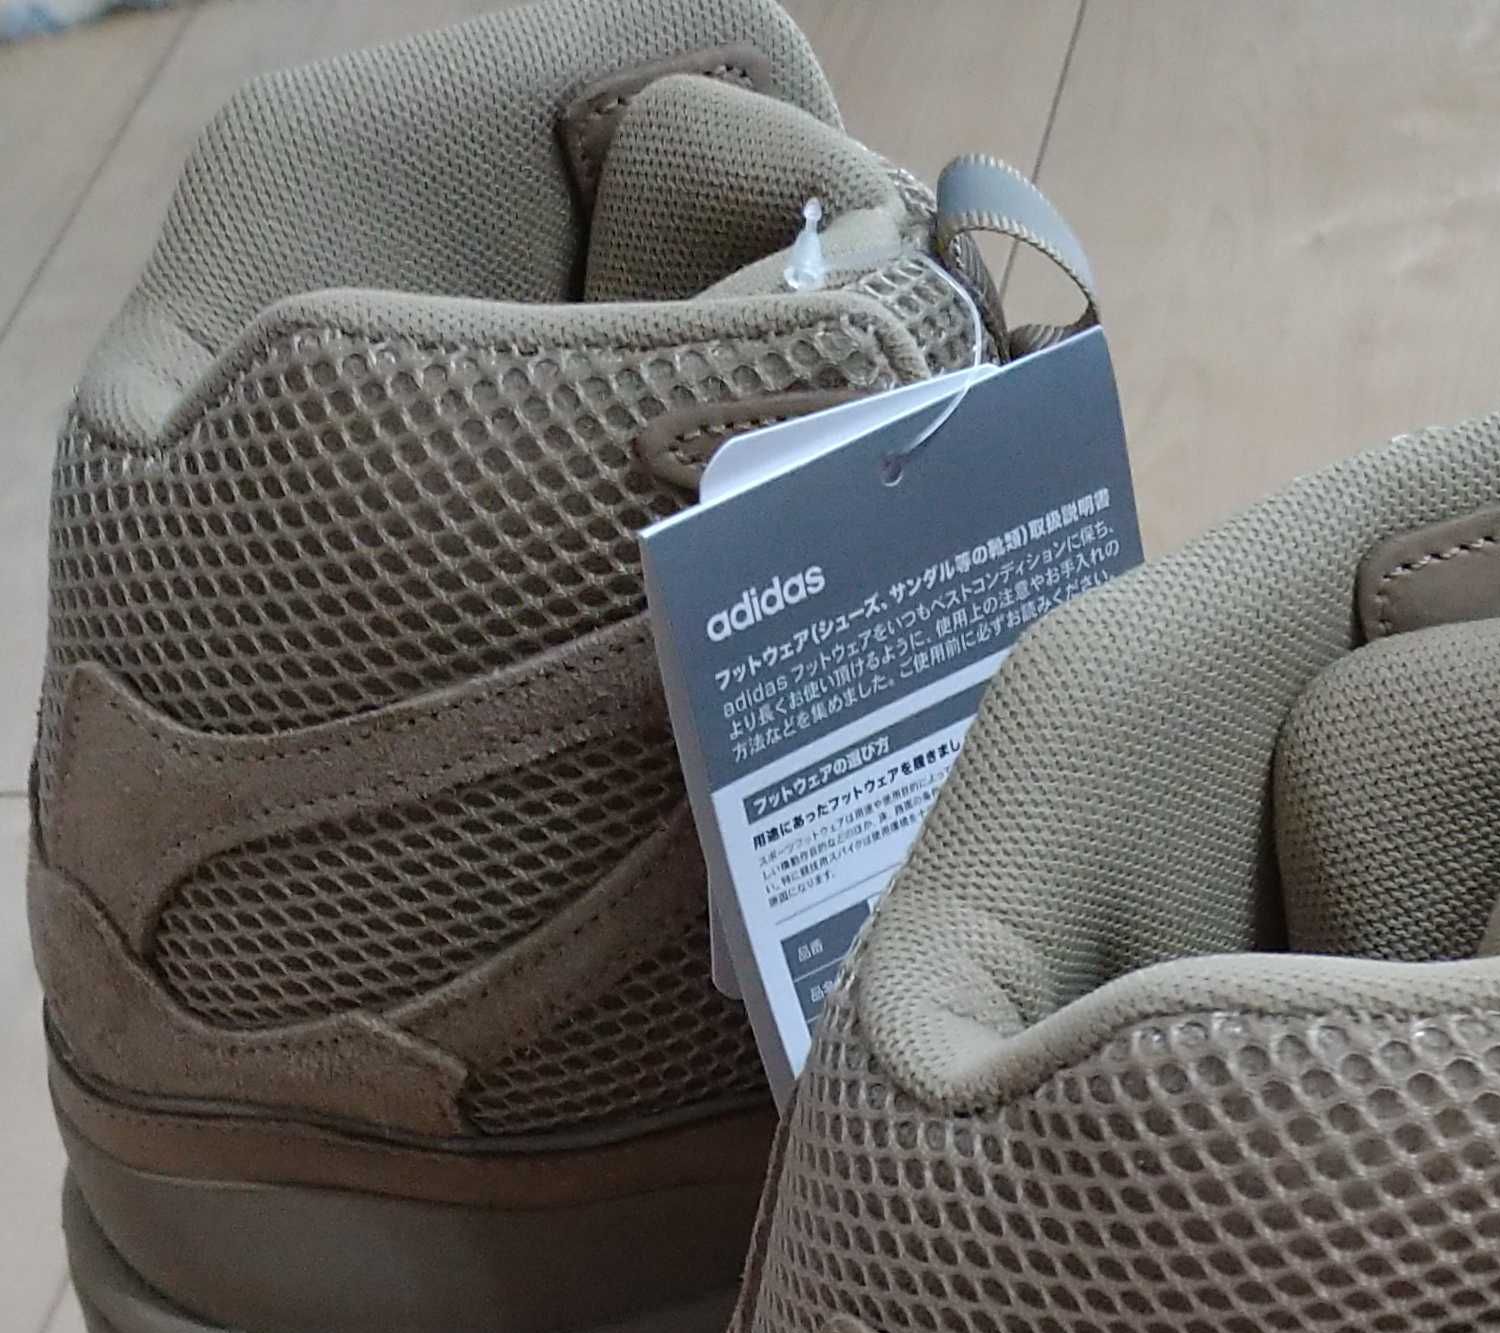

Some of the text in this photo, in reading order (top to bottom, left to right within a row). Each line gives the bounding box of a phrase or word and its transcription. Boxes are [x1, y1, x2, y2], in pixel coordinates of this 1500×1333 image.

[706, 566, 826, 642] adidas
[723, 675, 788, 719] adidas
[753, 735, 890, 815] フットウェアの選び方
[797, 938, 824, 963] 品番
